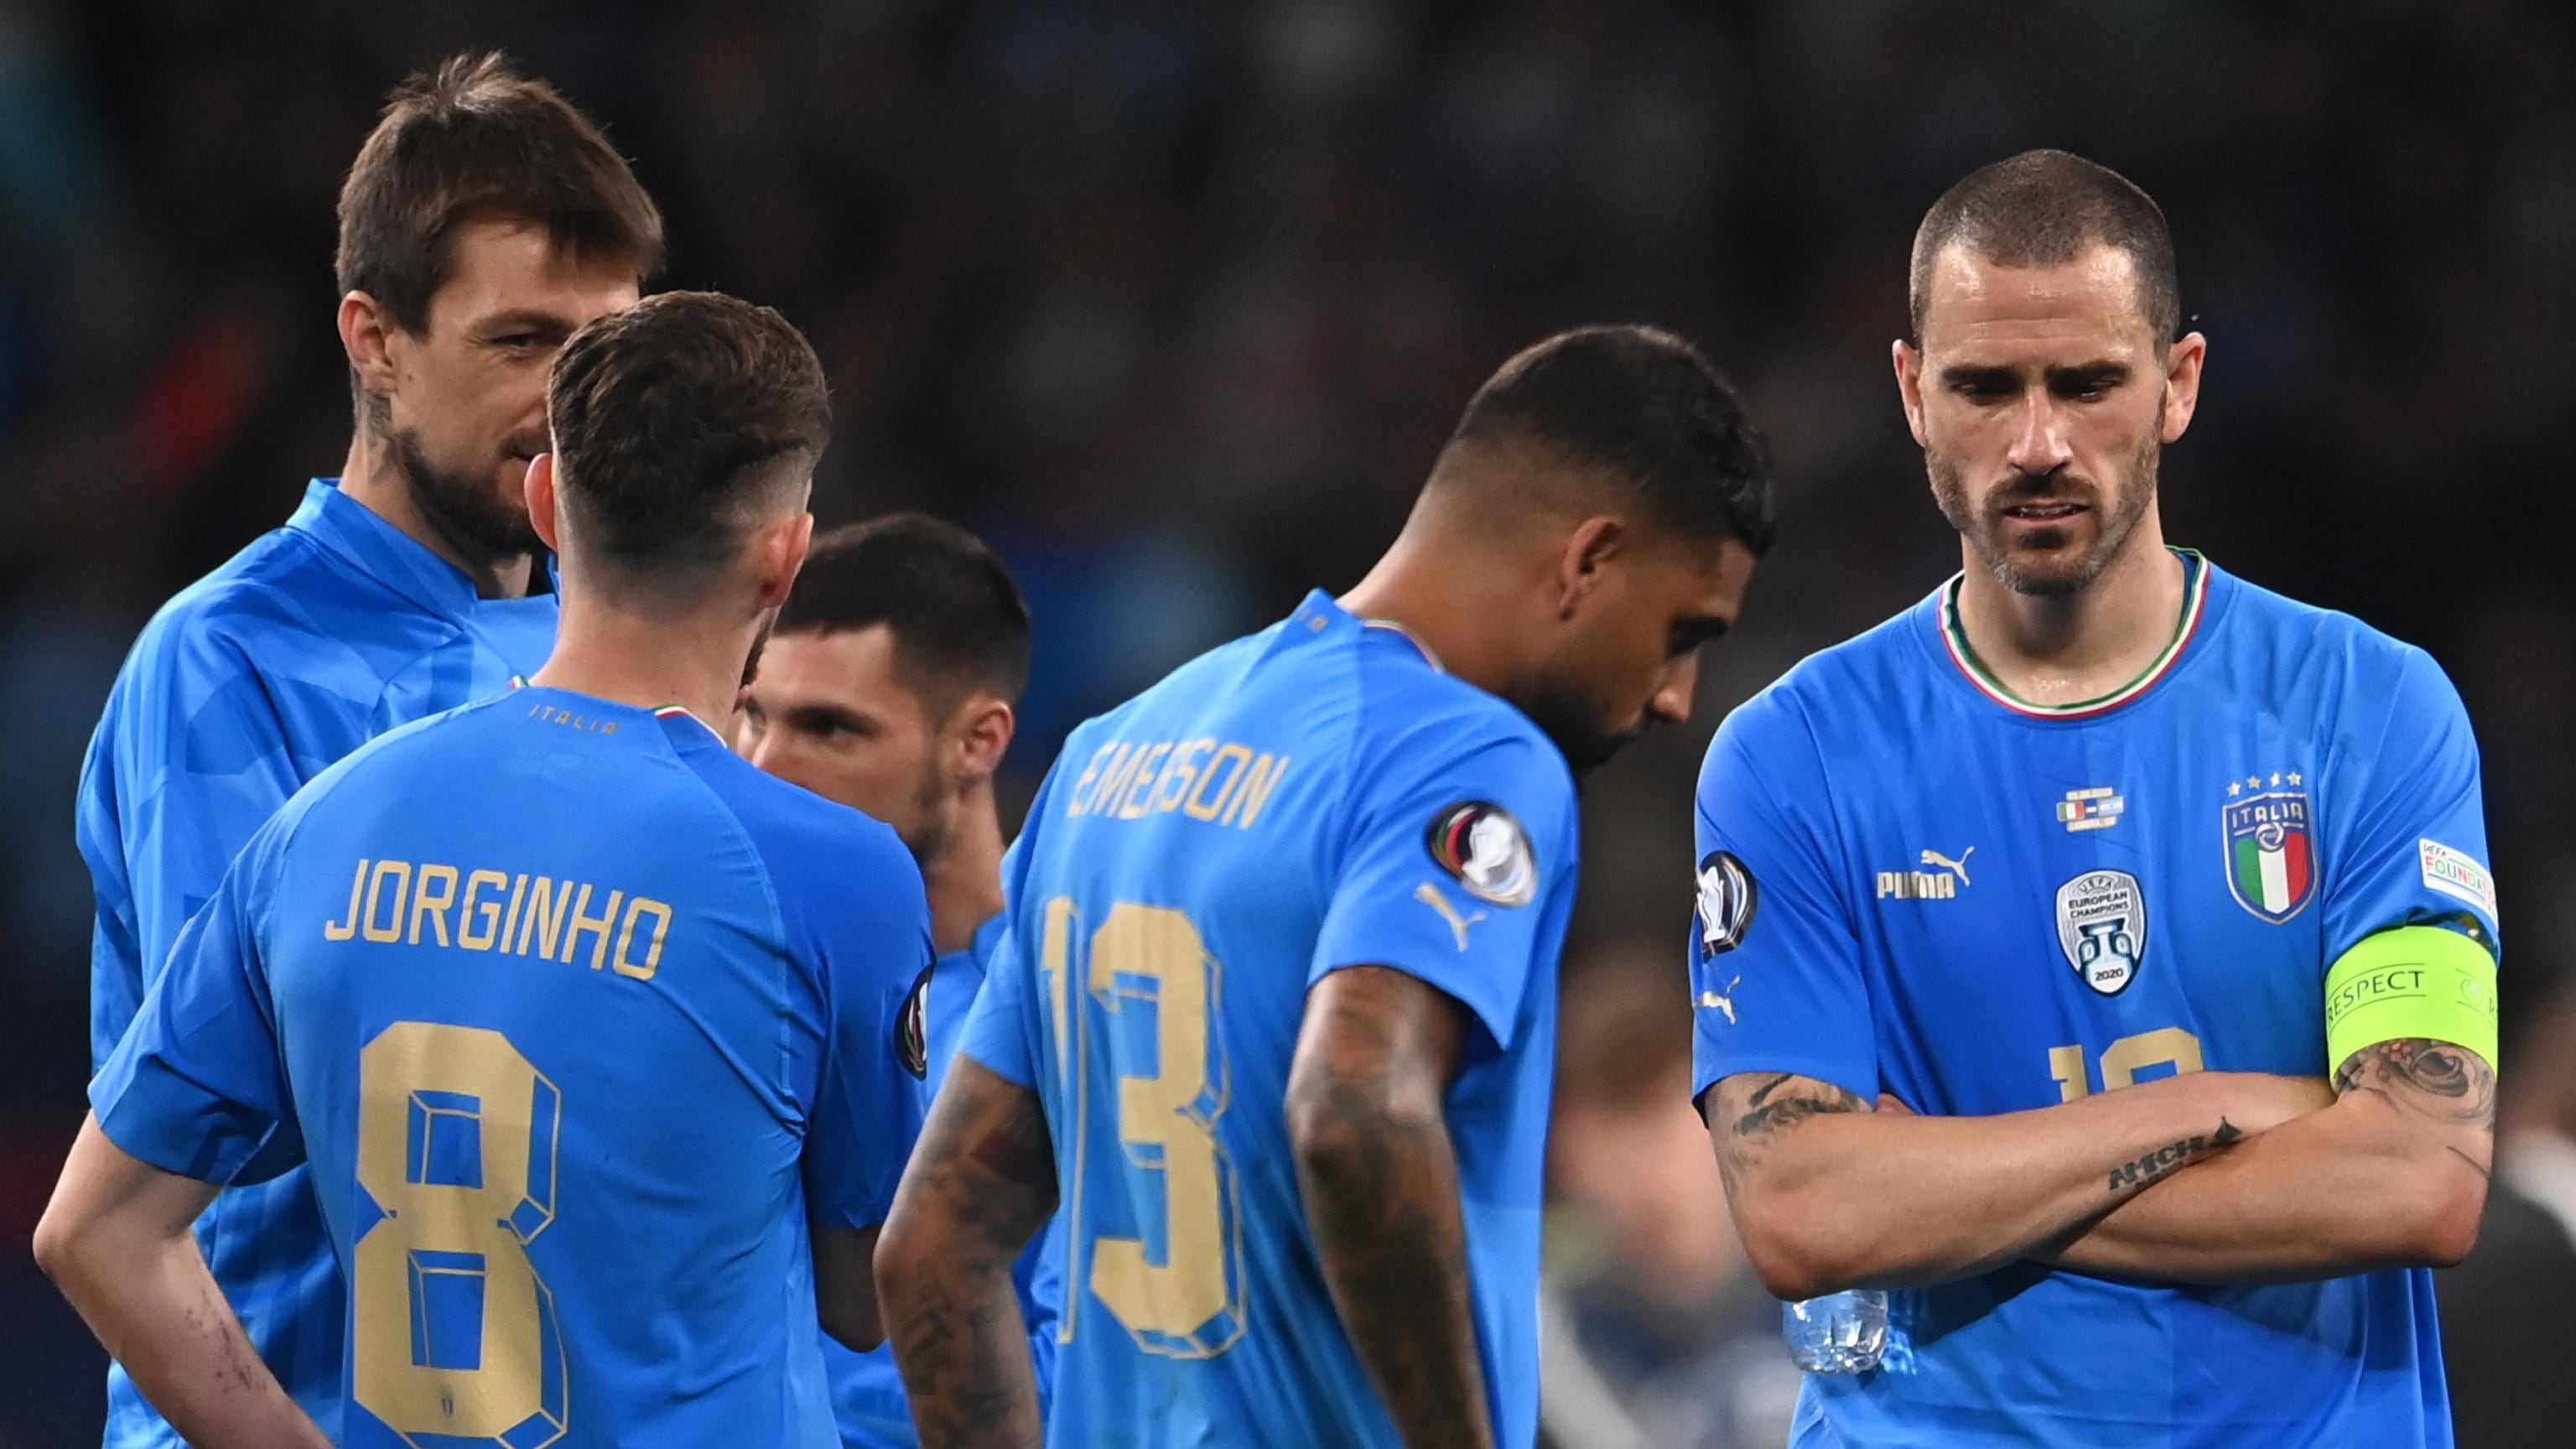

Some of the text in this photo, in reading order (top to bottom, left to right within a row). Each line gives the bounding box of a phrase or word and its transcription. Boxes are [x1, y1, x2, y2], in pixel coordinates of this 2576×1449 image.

[529, 704, 619, 735] ITALIA
[2231, 802, 2304, 828] ITALIA
[2424, 843, 2447, 857] UEFA
[1877, 870, 1956, 900] PUMA
[2079, 876, 2113, 893] UEFA
[2068, 890, 2128, 909] EUROPEAN
[2070, 901, 2129, 919] CHAMPIONS
[325, 859, 673, 980] JORGINHO
[2095, 966, 2124, 982] 2020
[2328, 969, 2425, 1024] RESPECT
[1041, 896, 1247, 1359] 13
[353, 1020, 569, 1449] 8
